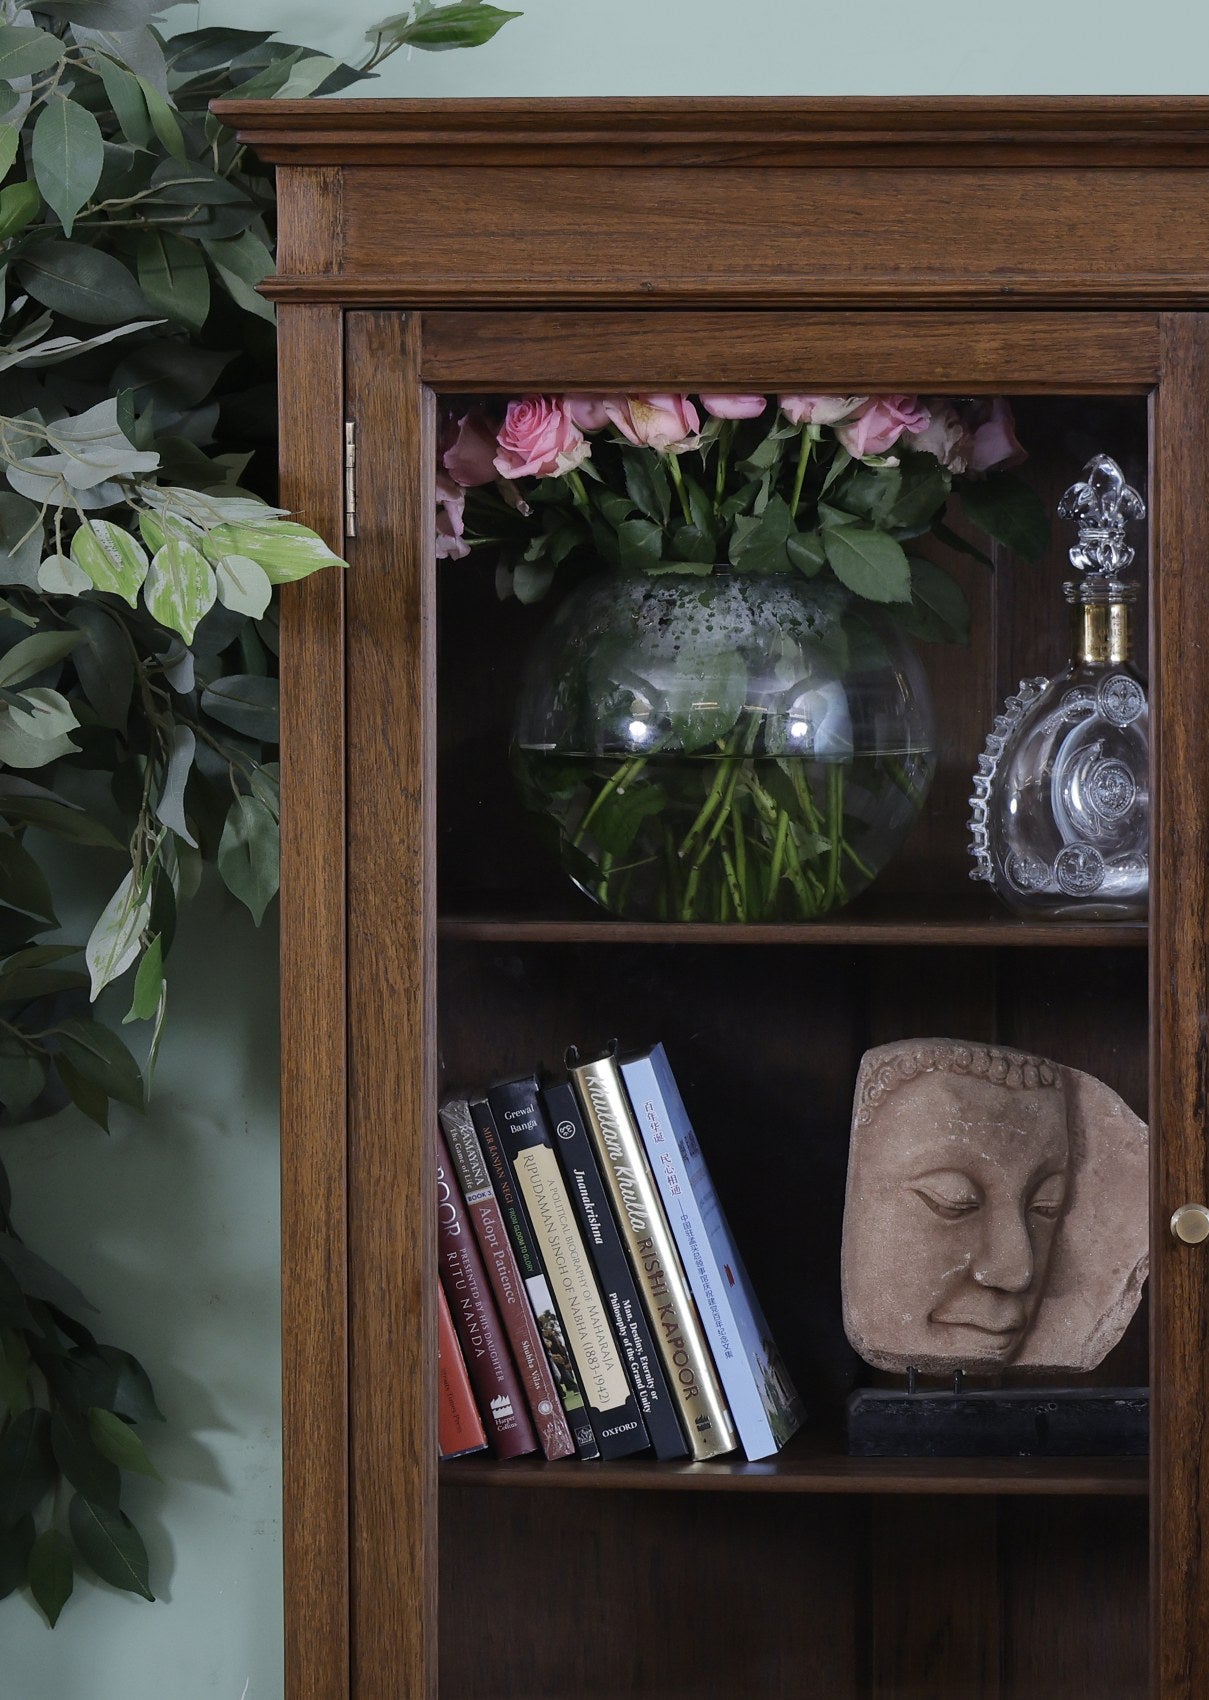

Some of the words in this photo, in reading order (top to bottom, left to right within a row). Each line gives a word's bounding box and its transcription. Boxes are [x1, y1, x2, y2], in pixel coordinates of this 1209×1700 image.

[504, 1104, 535, 1120] Grewal
[450, 1128, 458, 1142] The
[510, 1118, 538, 1134] Banga
[454, 1144, 464, 1163] Game
[460, 1124, 484, 1186] RAMAYANA
[585, 1075, 624, 1160] Khullam
[614, 1166, 647, 1233] Khulla
[644, 1102, 664, 1144] 百年华诞
[660, 1154, 682, 1196] 民心相通
[462, 1163, 468, 1174] of
[482, 1126, 494, 1144] MIR
[488, 1145, 505, 1178] RANJAN
[501, 1182, 514, 1204] NEGI
[464, 1174, 474, 1189] Life
[524, 1154, 556, 1234] RIPUDAMAN
[468, 1192, 486, 1202] BOOK
[550, 1186, 570, 1235] POLITICAL
[573, 1168, 604, 1245] Jnanakrishna
[508, 1207, 518, 1222] FROM
[513, 1221, 525, 1244] GLOOM
[480, 1207, 499, 1248] Adopt
[494, 1250, 516, 1304] Patience
[520, 1243, 527, 1254] TO
[522, 1252, 534, 1272] GLORY
[548, 1235, 568, 1275] SINGH
[566, 1234, 590, 1288] BIOGRAPHY
[562, 1276, 576, 1293] OF
[583, 1290, 593, 1302] OF
[446, 1252, 467, 1290] RITU
[460, 1298, 486, 1358] NANDA
[460, 1248, 480, 1299] PRESENTED
[475, 1300, 484, 1312] BY
[480, 1314, 488, 1330] HIS
[484, 1332, 504, 1382] DAUGHTER
[568, 1296, 588, 1341] NABHA
[608, 1292, 628, 1338] Philosophy
[636, 1238, 670, 1298] RISHI
[658, 1305, 700, 1401] KAPOOR
[587, 1304, 615, 1372] MAHARAJA
[622, 1299, 633, 1322] Man,
[629, 1323, 644, 1356] Destiny,
[639, 1355, 656, 1390] Eternity
[650, 1391, 658, 1400] or
[624, 1336, 632, 1348] of
[522, 1340, 534, 1369] Shubha
[532, 1370, 541, 1390] Vilas
[626, 1348, 636, 1362] the
[582, 1341, 611, 1404] (1883-1942)
[630, 1362, 646, 1389] Grand
[639, 1389, 652, 1414] Unity
[495, 1415, 516, 1426] Harper
[497, 1422, 518, 1432] Collins
[602, 1421, 638, 1438] OXFORD
